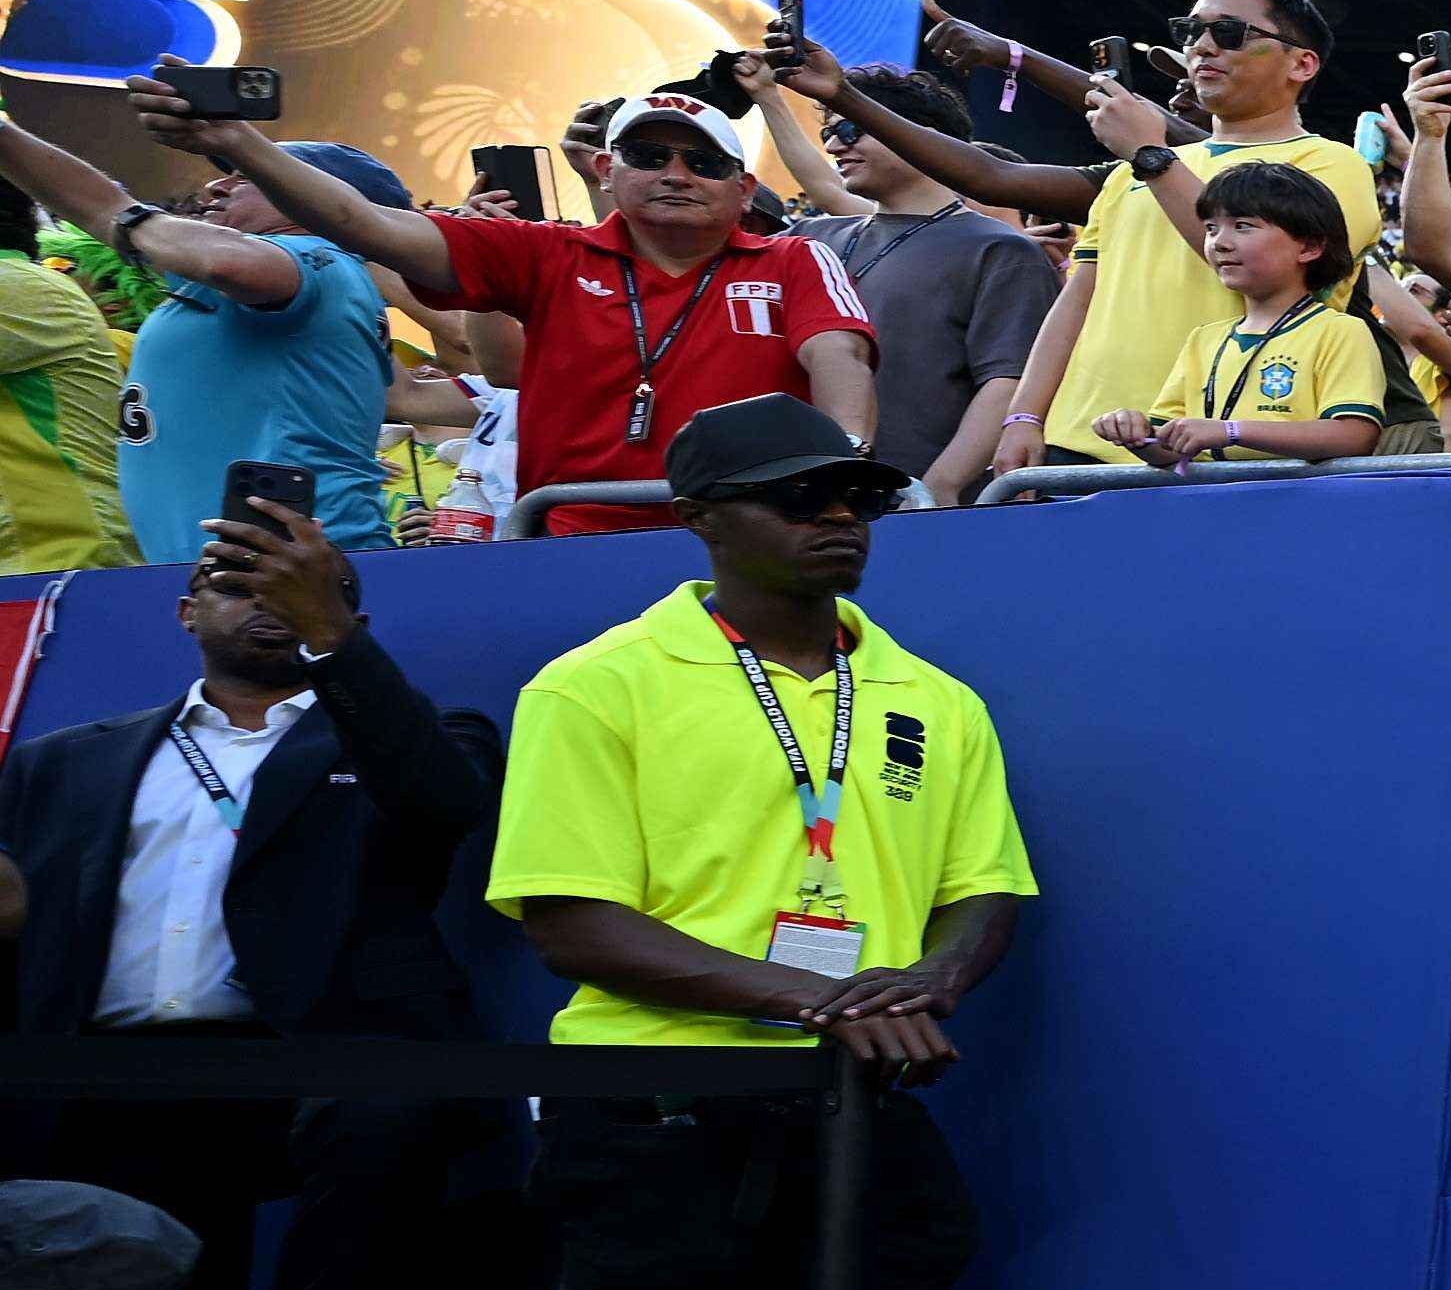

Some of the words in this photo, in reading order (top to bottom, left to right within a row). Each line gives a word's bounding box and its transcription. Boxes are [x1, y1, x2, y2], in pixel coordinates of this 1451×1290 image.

[731, 283, 778, 298] FPF
[837, 672, 852, 708] WORLD
[836, 708, 851, 731] CUP
